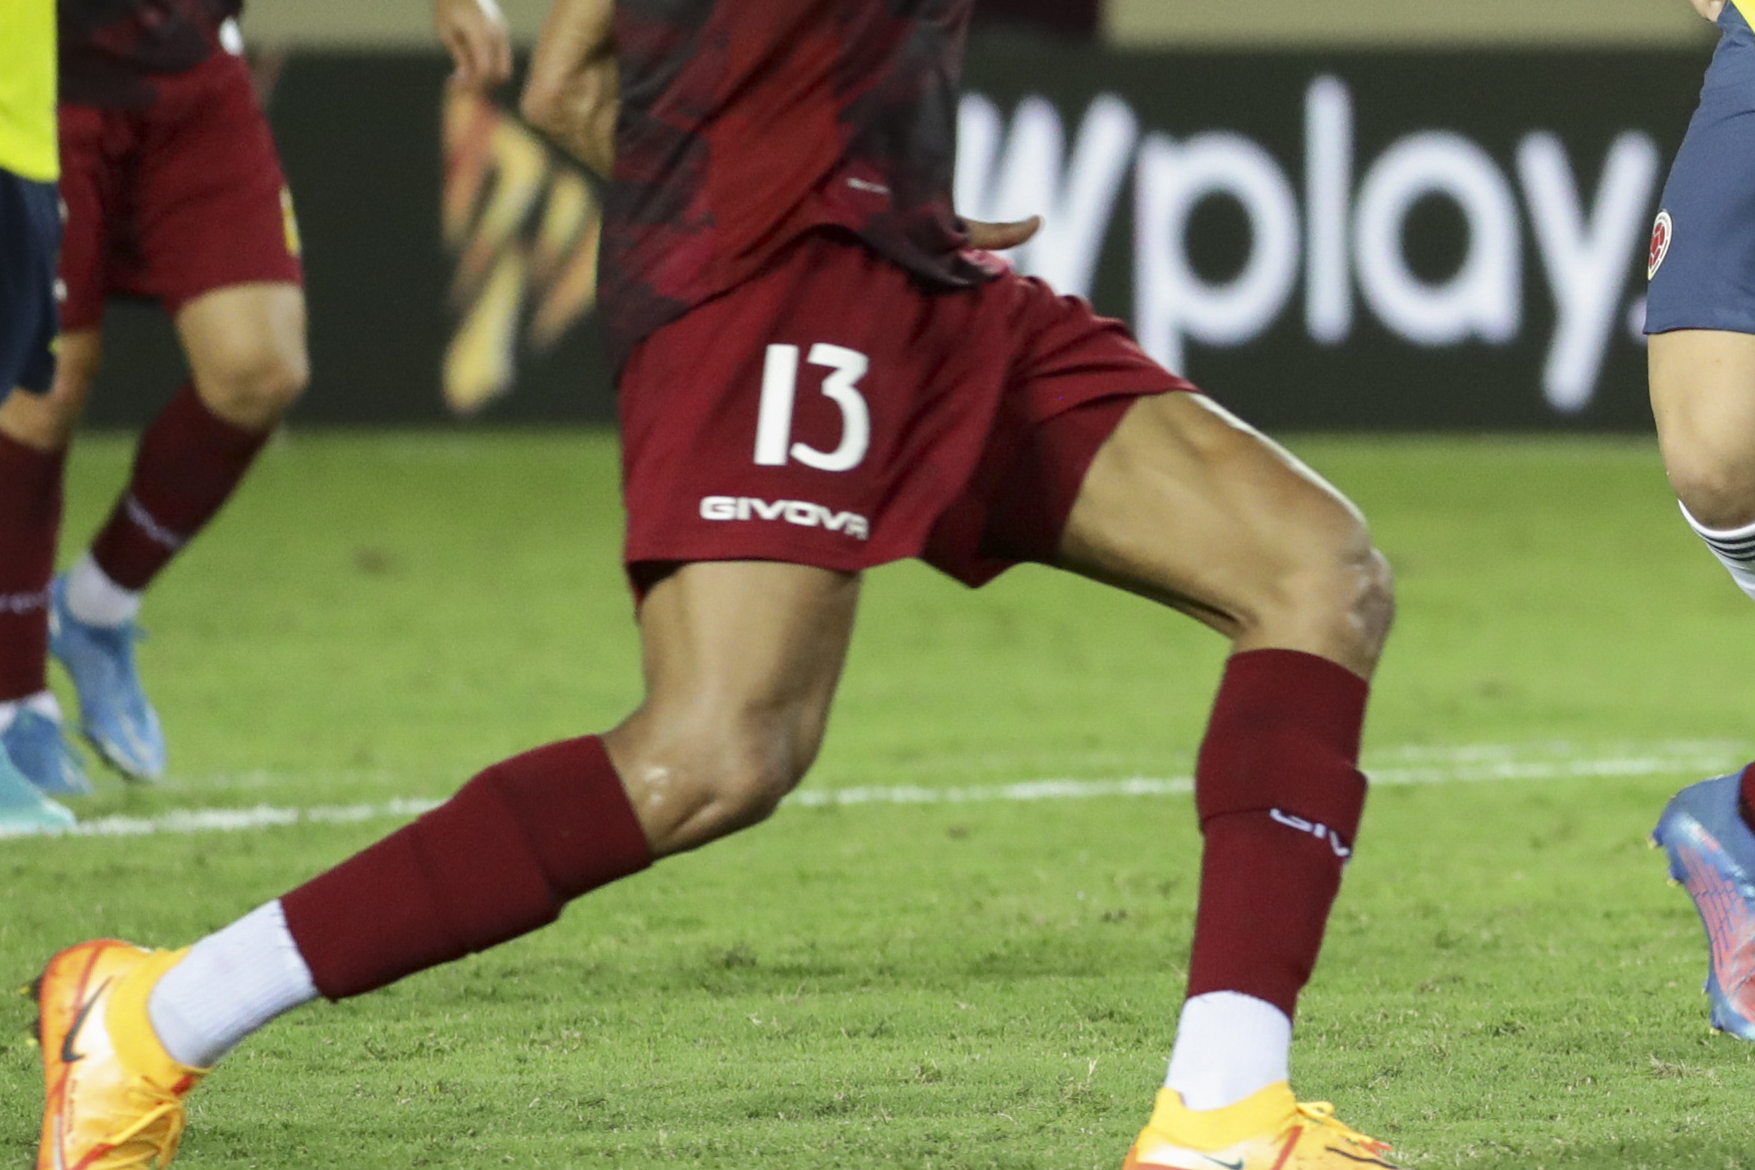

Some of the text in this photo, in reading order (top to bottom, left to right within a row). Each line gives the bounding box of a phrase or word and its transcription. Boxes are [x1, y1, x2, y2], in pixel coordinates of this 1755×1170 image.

[753, 342, 871, 471] 13
[700, 495, 869, 541] GIVOVA
[1269, 807, 1350, 857] GIV
